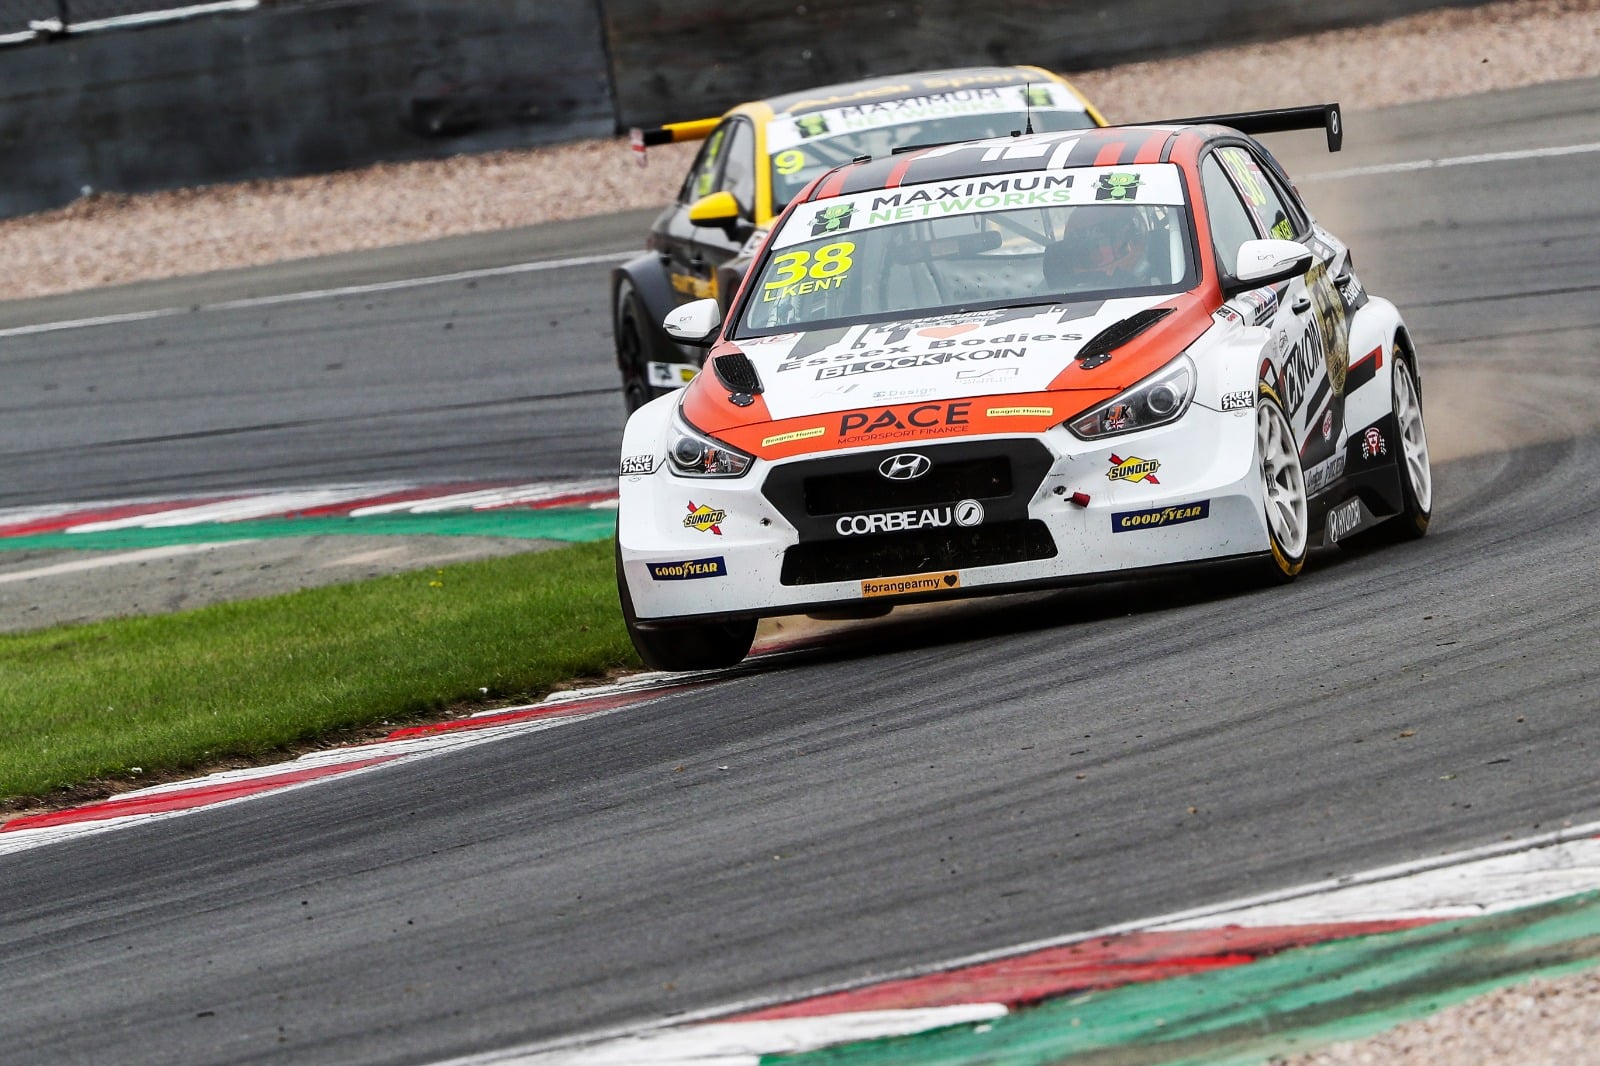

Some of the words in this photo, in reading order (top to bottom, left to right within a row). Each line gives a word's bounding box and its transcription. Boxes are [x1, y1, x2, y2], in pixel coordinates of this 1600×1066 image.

[840, 89, 1001, 118] MAXIMUM
[844, 101, 1003, 129] NETWORKS
[774, 150, 805, 175] 9
[871, 175, 1075, 211] MAXIMUM
[868, 189, 1072, 226] NETWORKS
[764, 241, 856, 290] 38
[776, 346, 909, 373] Essex
[928, 333, 1084, 350] Bodies
[815, 347, 1027, 382] BLOCKKOIN
[838, 401, 974, 437] PACE
[836, 430, 916, 446] MOTORSPORT
[919, 425, 970, 436] FINANCE
[1110, 460, 1157, 480] SUNOCO
[685, 511, 723, 526] SUNOCO
[835, 506, 952, 536] CORBEAU
[1120, 506, 1202, 528] GOODYEAR
[654, 561, 719, 578] GOODYEAR
[863, 577, 941, 594] #orangearmy
